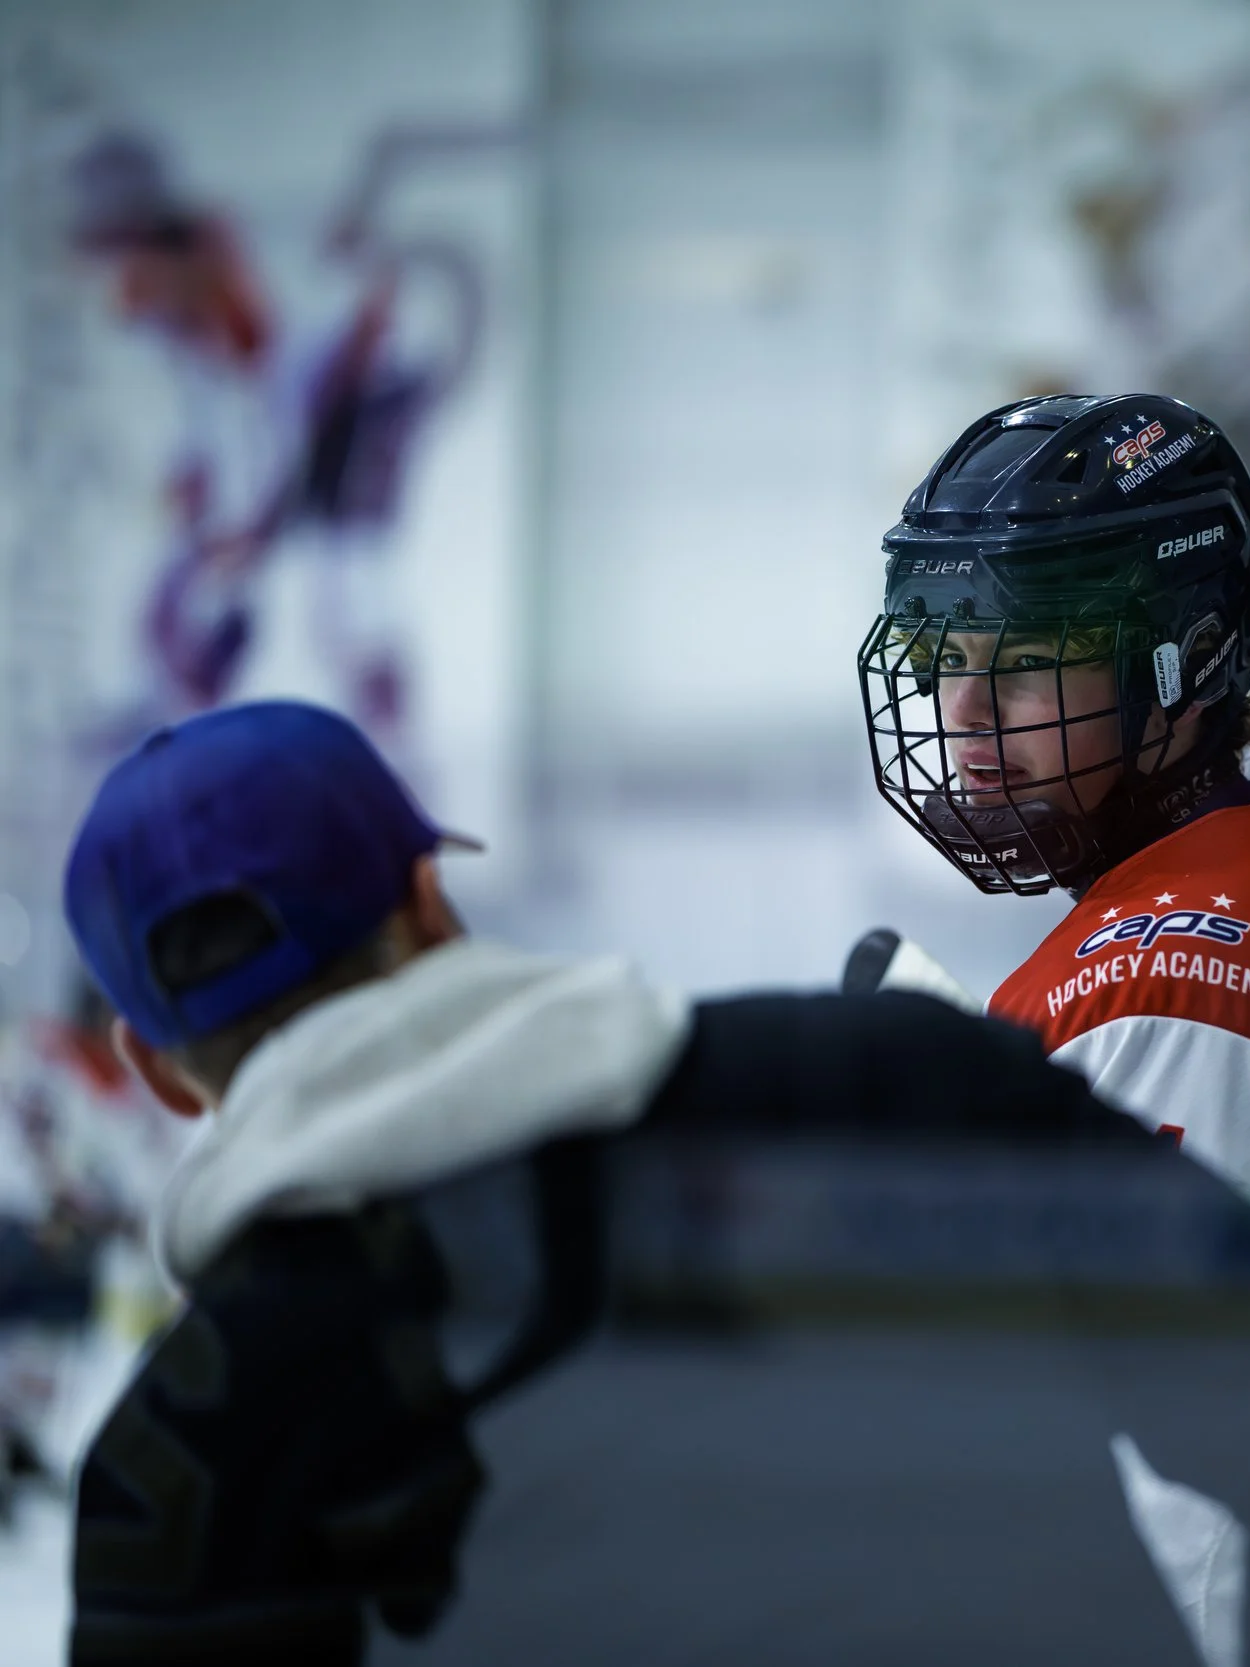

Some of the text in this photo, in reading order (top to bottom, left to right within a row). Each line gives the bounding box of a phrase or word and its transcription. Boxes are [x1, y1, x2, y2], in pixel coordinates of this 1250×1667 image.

[1113, 420, 1166, 464] caps
[1117, 433, 1197, 494] HOCKEY ACADEMY
[1156, 651, 1169, 700] BAUER
[1195, 629, 1238, 688] BAUER
[1047, 952, 1144, 1018] HOCKEY
